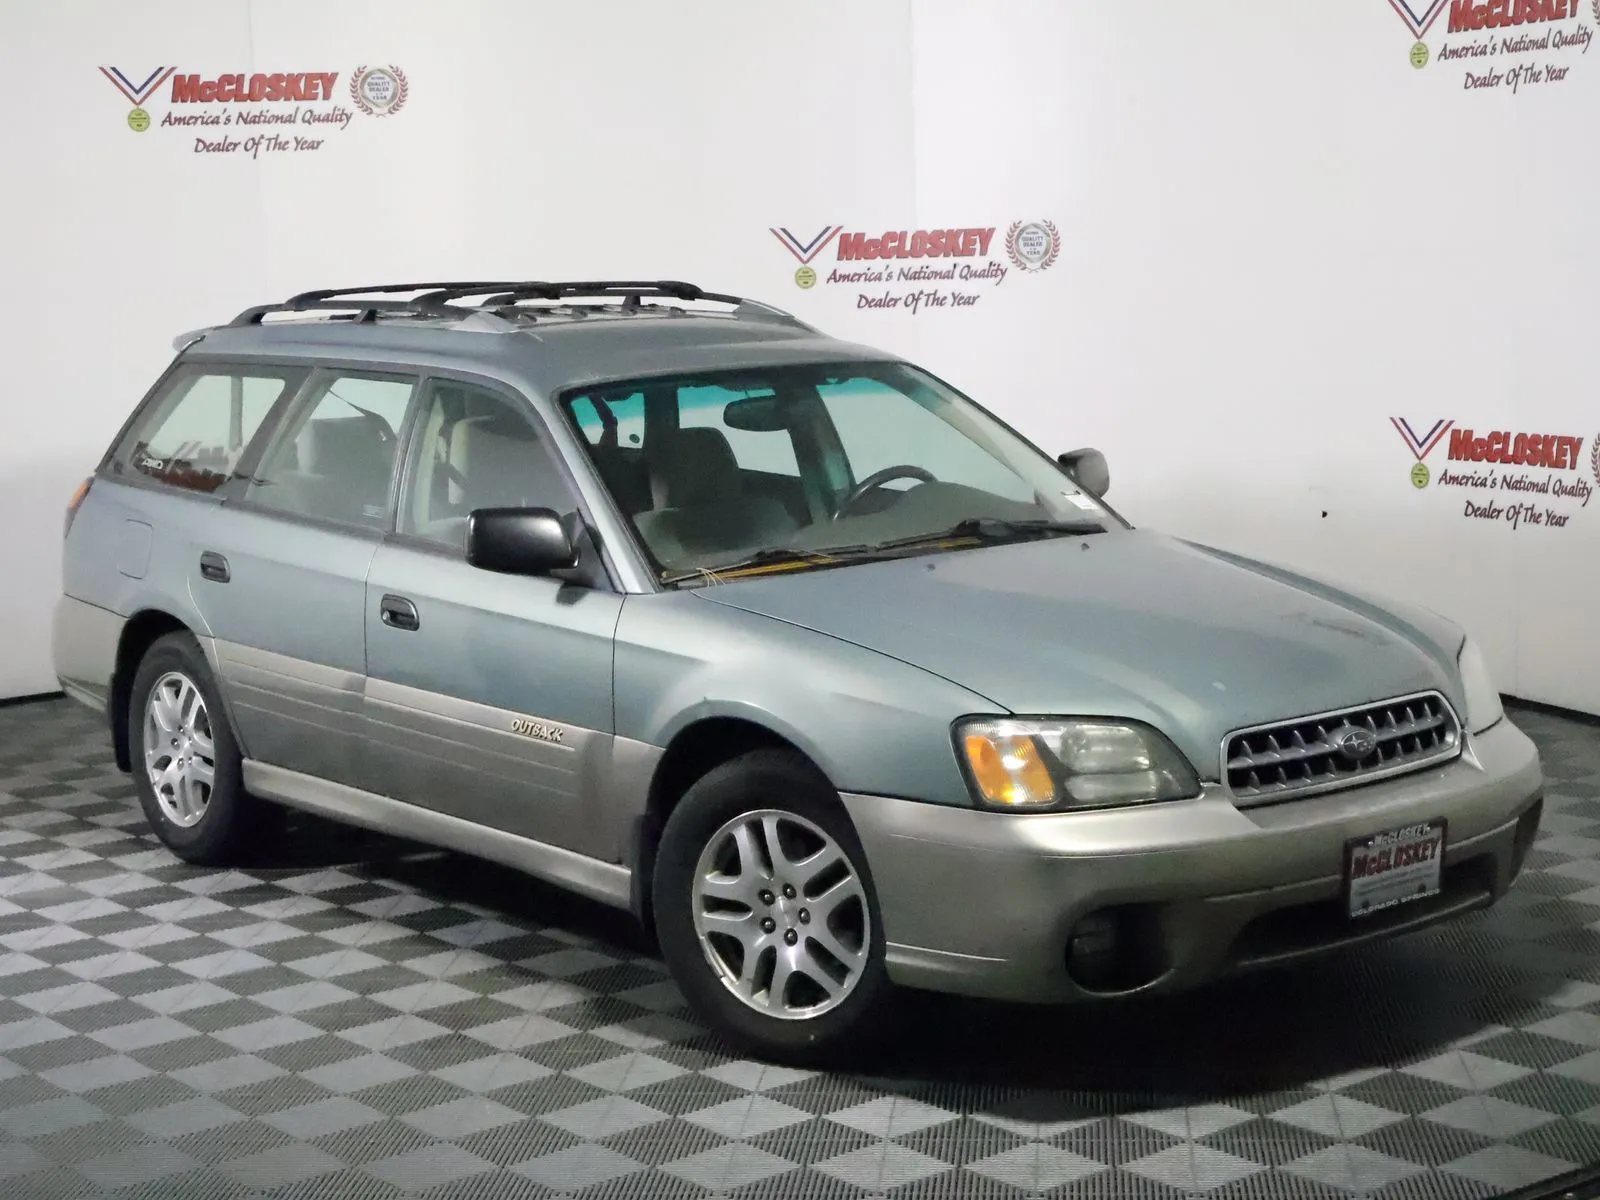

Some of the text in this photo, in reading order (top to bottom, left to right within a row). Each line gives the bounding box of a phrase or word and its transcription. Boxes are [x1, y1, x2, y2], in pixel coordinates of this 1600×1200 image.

[1437, 35, 1497, 62] America's
[1500, 28, 1551, 55] National
[1552, 23, 1593, 54] Quality
[171, 72, 339, 103] McCLOSKEY
[1464, 62, 1569, 94] Dealer Of The Year
[160, 108, 231, 127] America's
[236, 106, 299, 125] National
[301, 106, 353, 130] Quality
[194, 134, 324, 159] Dealer Of The Year
[837, 227, 996, 261] McCLOSKEY
[826, 264, 893, 284] America's
[897, 262, 957, 281] National
[959, 261, 1007, 286] Quality
[857, 289, 980, 315] Dealer Of The Year
[1447, 428, 1584, 470] McCLOSKEY
[1438, 469, 1497, 489] America's
[1500, 474, 1552, 495] National
[1552, 477, 1593, 507] Quality
[1464, 500, 1569, 530] Dealer Of The Year
[511, 718, 563, 742] OUTBACK
